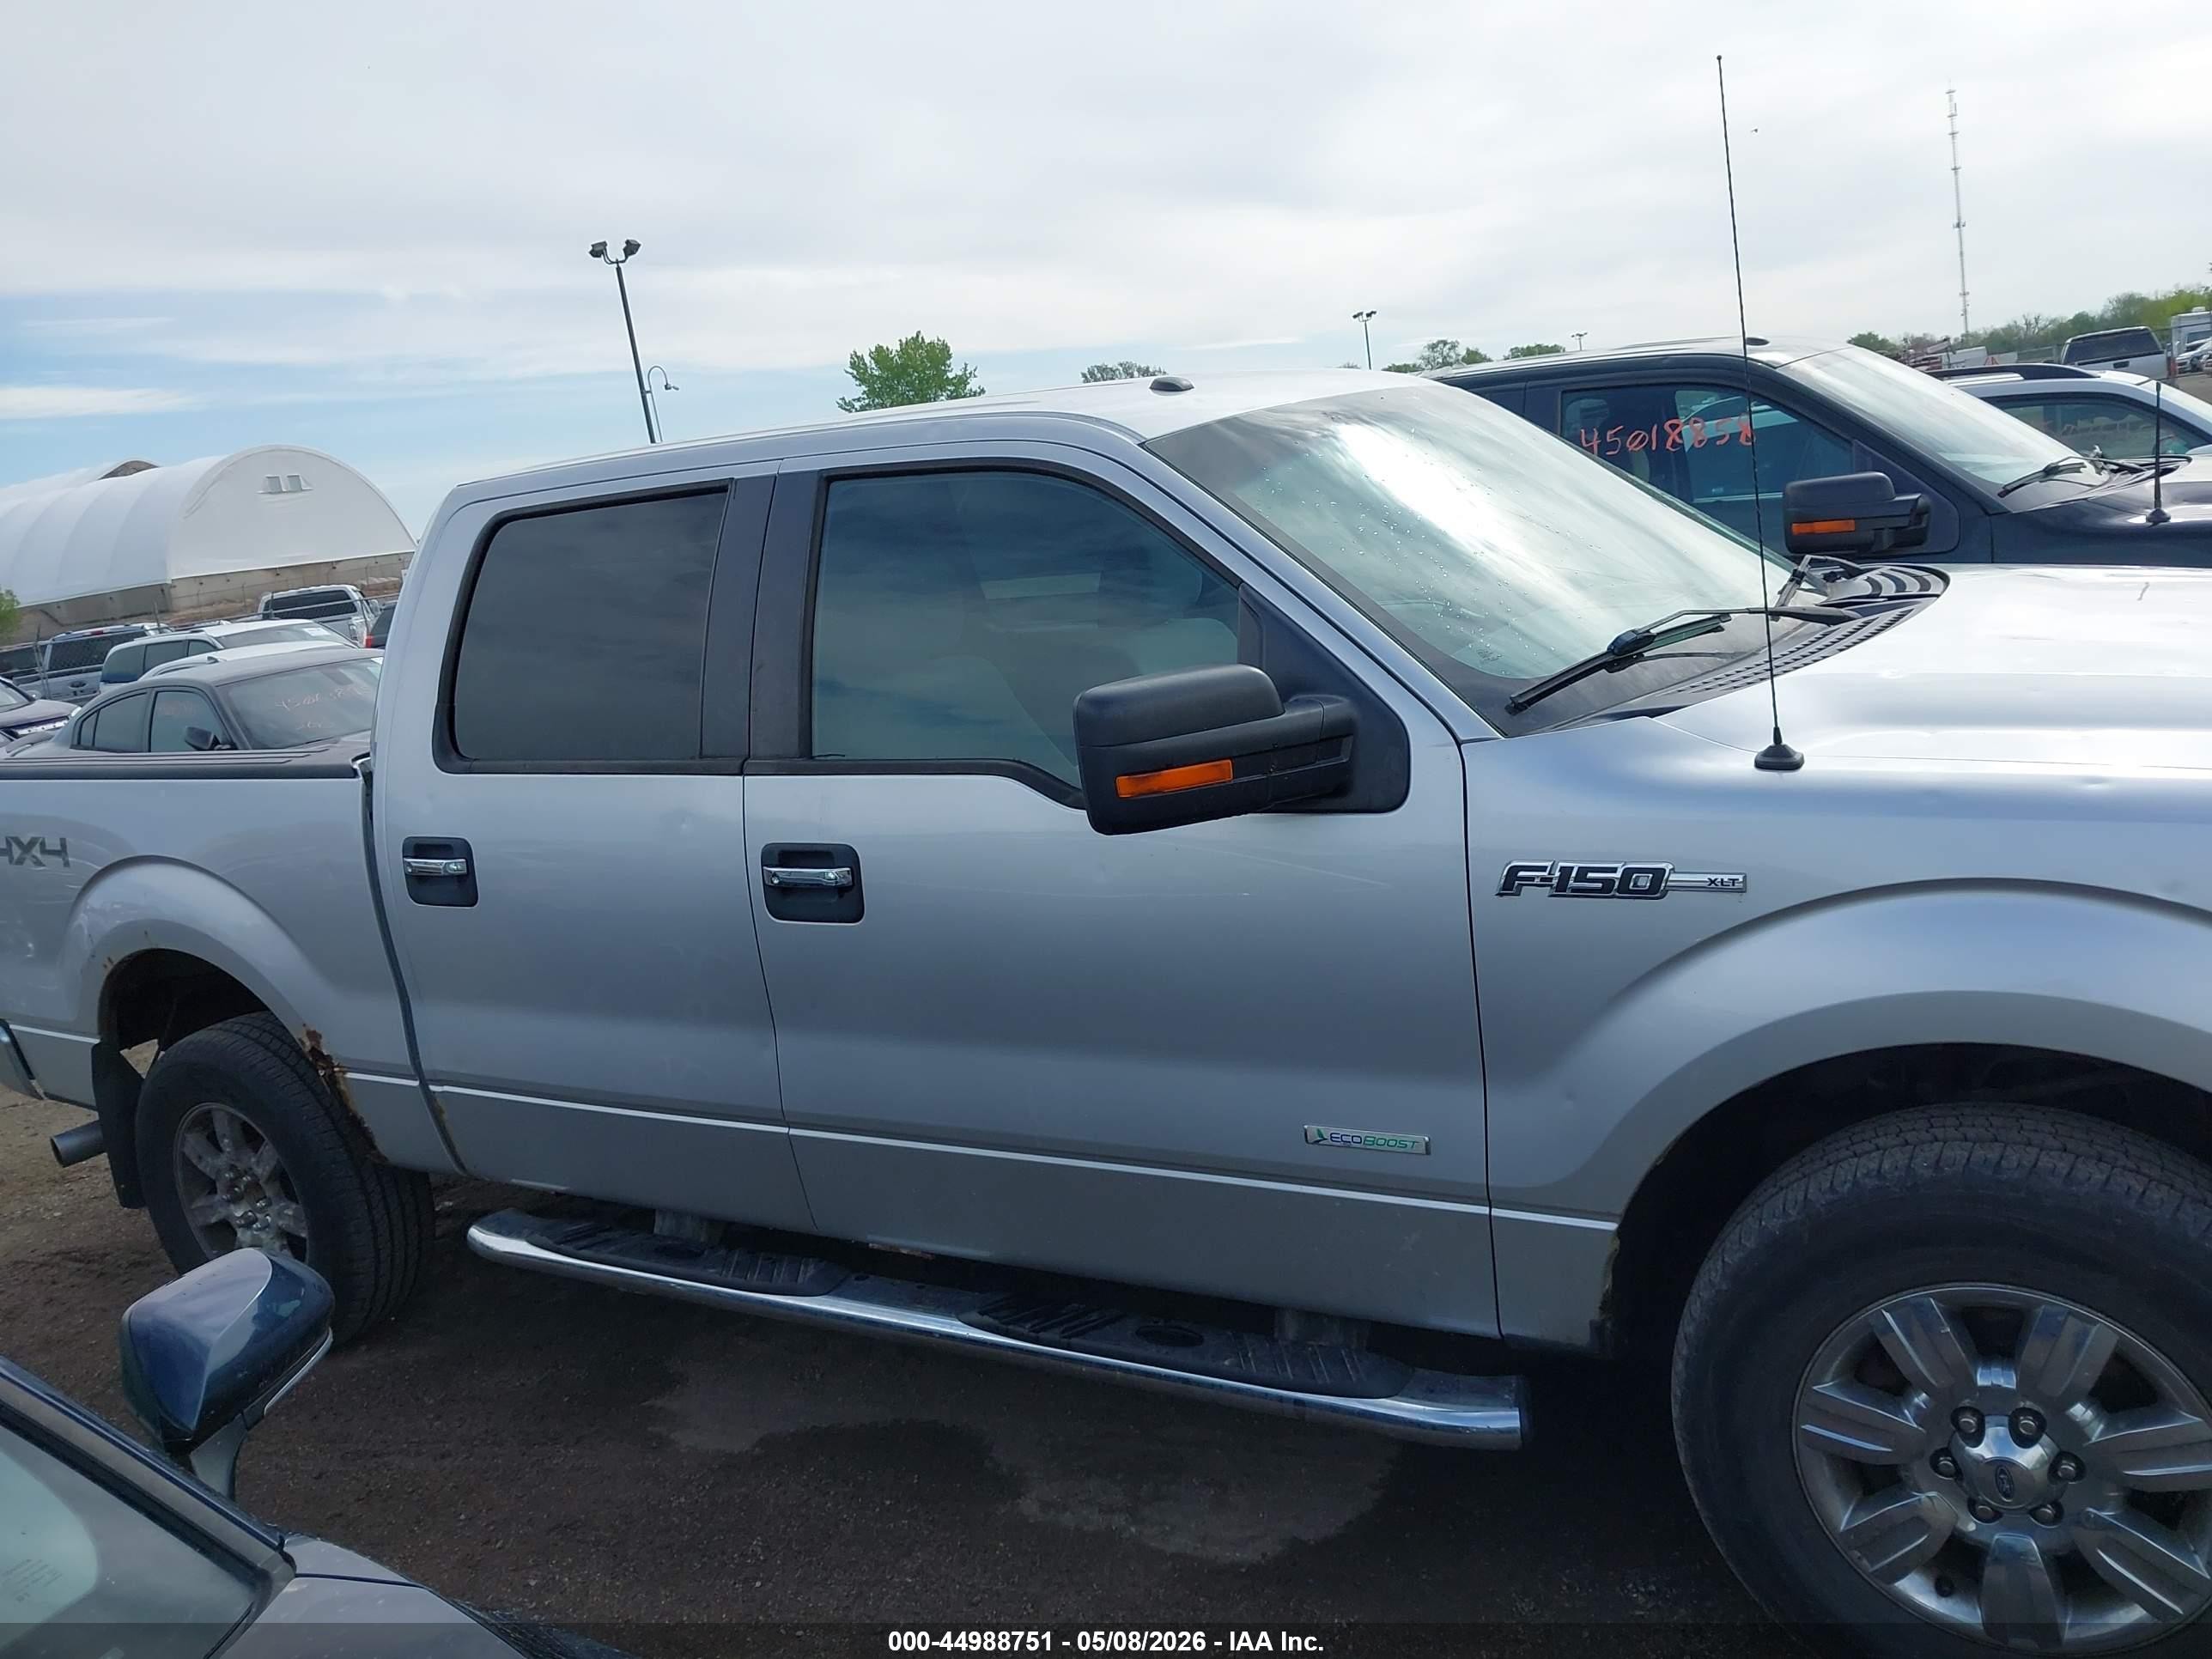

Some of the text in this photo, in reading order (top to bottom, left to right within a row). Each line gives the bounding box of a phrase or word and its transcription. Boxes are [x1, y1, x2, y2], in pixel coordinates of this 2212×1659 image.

[1496, 860, 1740, 900] F-150 XLT
[1329, 1132, 1418, 1149] ECOBOOST
